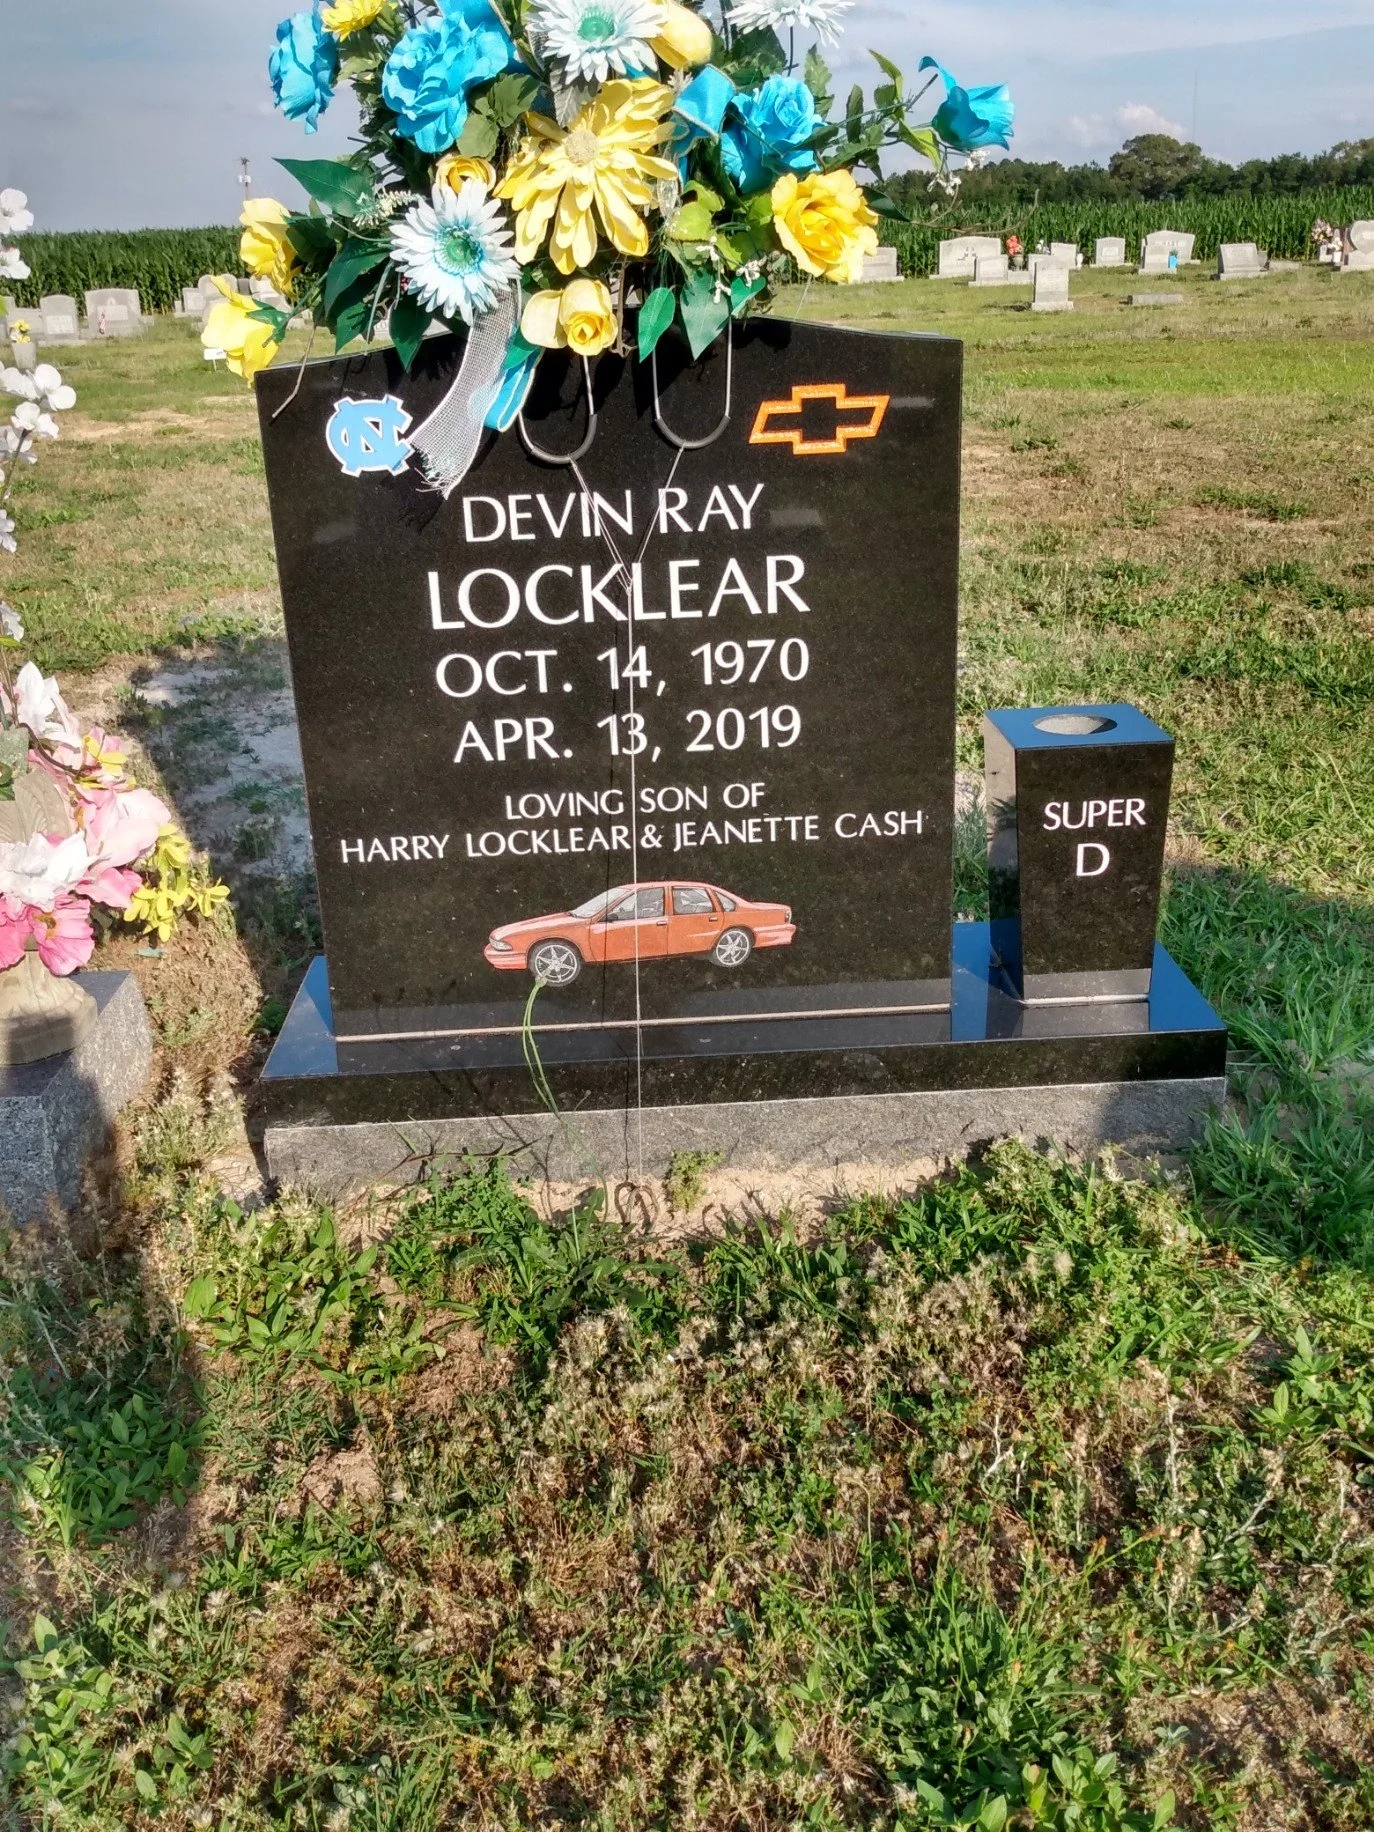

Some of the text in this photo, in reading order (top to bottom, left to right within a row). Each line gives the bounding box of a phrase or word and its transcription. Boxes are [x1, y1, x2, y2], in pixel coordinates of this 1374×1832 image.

[462, 483, 765, 543] DEVIN RAY
[428, 555, 811, 630] LOCKLEAR
[435, 637, 810, 698] OCT. 14, 1970
[453, 705, 802, 764] APR. 13, 2019
[505, 781, 766, 820] LOVING SON OF
[1043, 797, 1148, 831] SUPER
[340, 809, 923, 864] HARRY LOCKLEAR & JEANETTE CASH
[1075, 842, 1111, 878] D
